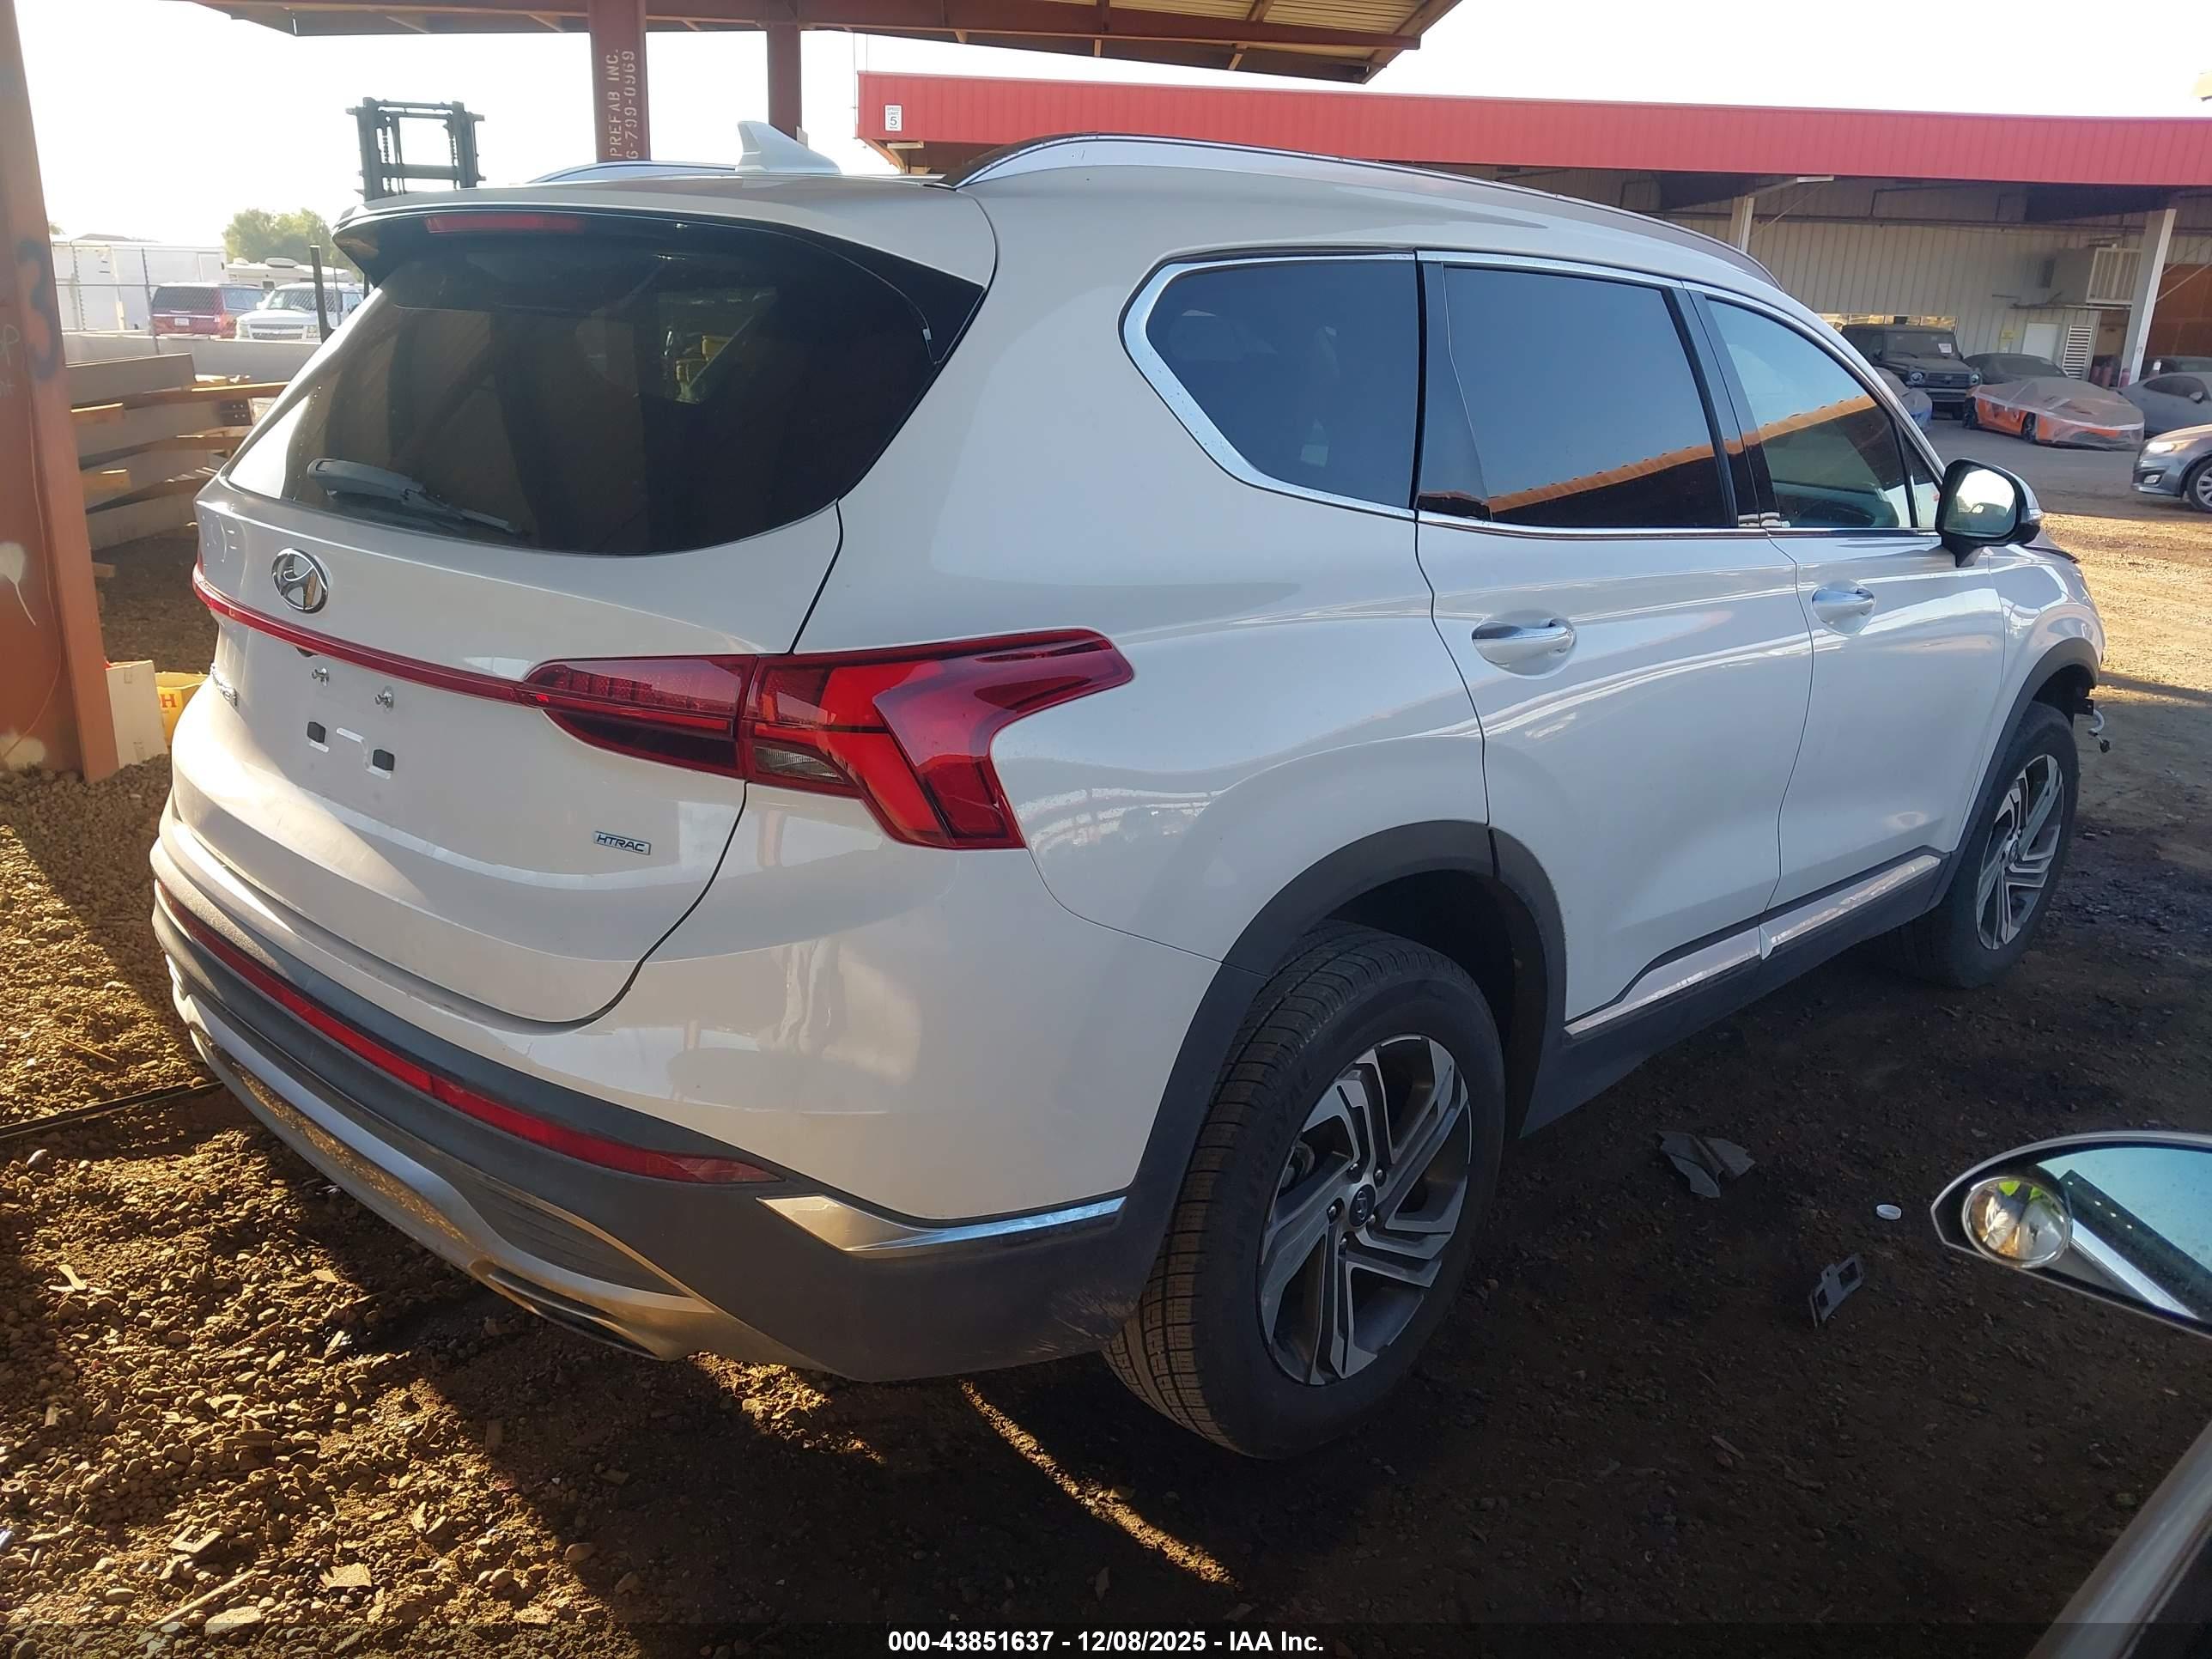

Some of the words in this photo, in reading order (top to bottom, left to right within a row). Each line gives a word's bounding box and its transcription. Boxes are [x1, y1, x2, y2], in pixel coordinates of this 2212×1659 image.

[605, 48, 620, 82] INC.
[607, 91, 623, 157] PREFAB
[890, 116, 897, 126] 5
[597, 834, 646, 852] HTRAC
